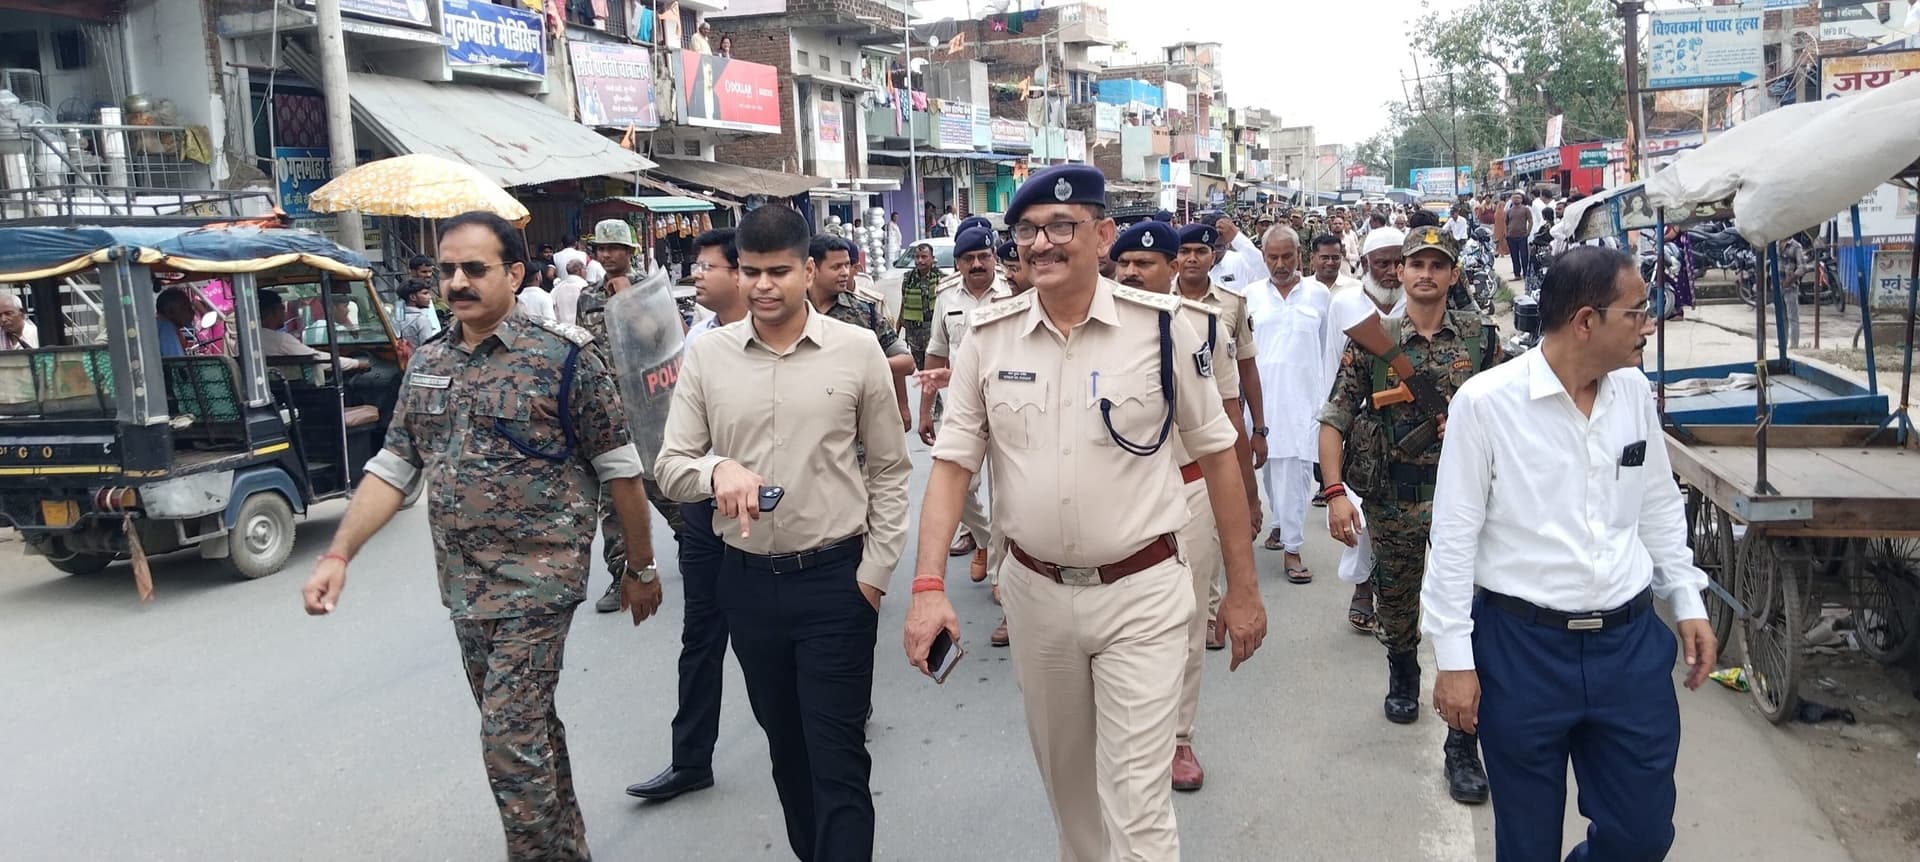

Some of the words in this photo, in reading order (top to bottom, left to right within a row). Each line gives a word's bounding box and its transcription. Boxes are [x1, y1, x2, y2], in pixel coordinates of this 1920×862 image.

[445, 10, 497, 50] गुलमोहर
[497, 15, 542, 54] मेडिसिन
[1652, 16, 1703, 36] विश्वकर्मा
[1705, 18, 1733, 33] पावर
[1833, 70, 1896, 92] जय
[286, 150, 326, 189] गुलमोहर
[1871, 236, 1886, 245] JAY
[1879, 274, 1902, 294] एवं
